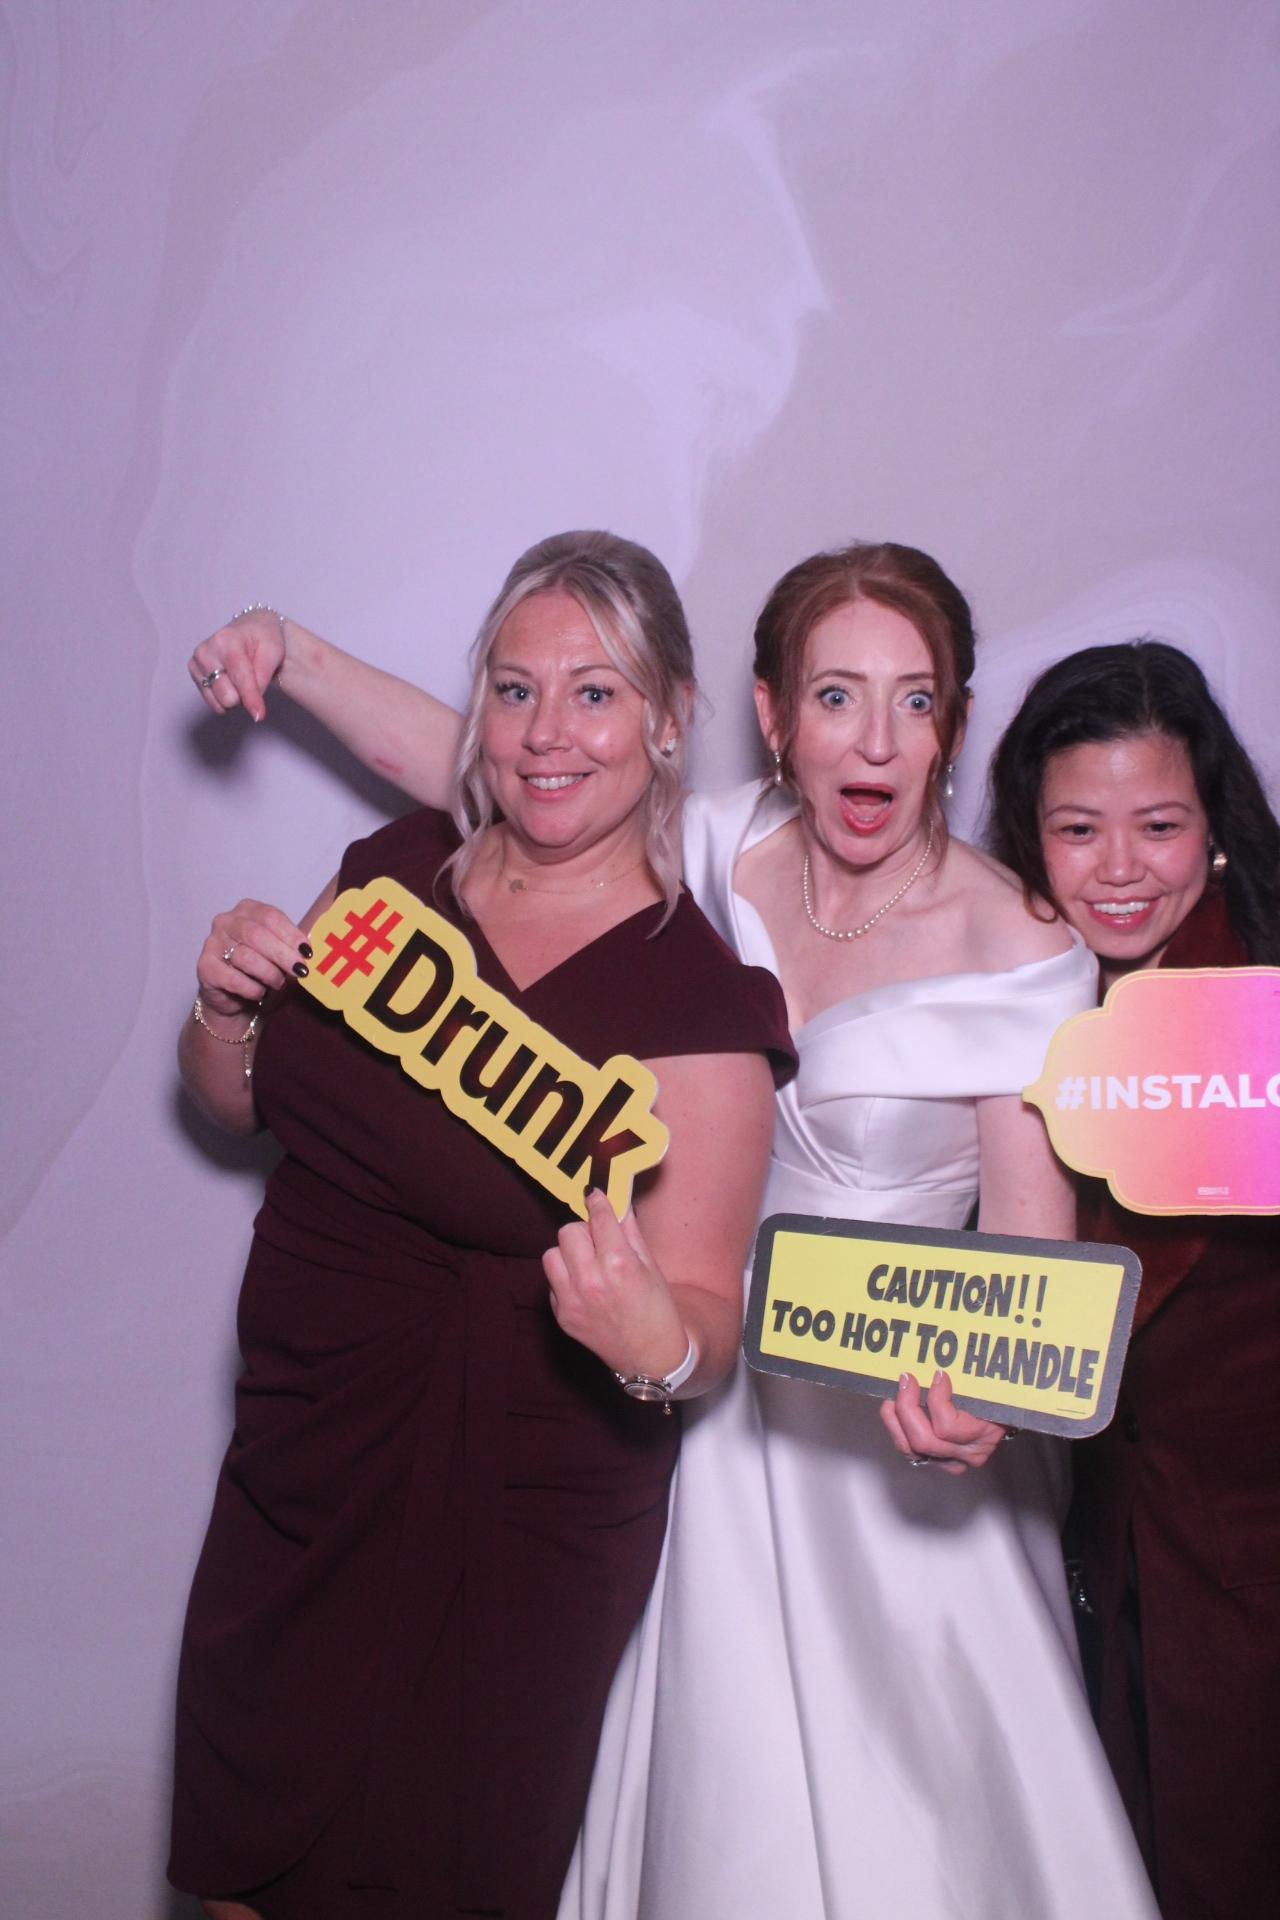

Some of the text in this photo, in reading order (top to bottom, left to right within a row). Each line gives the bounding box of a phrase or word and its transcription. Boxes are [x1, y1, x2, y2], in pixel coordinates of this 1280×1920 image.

[316, 898, 647, 1193] #Drunk
[866, 1264, 1048, 1328] CAUTION!!
[771, 1299, 1100, 1400] TOO HOT TO HANDLE
